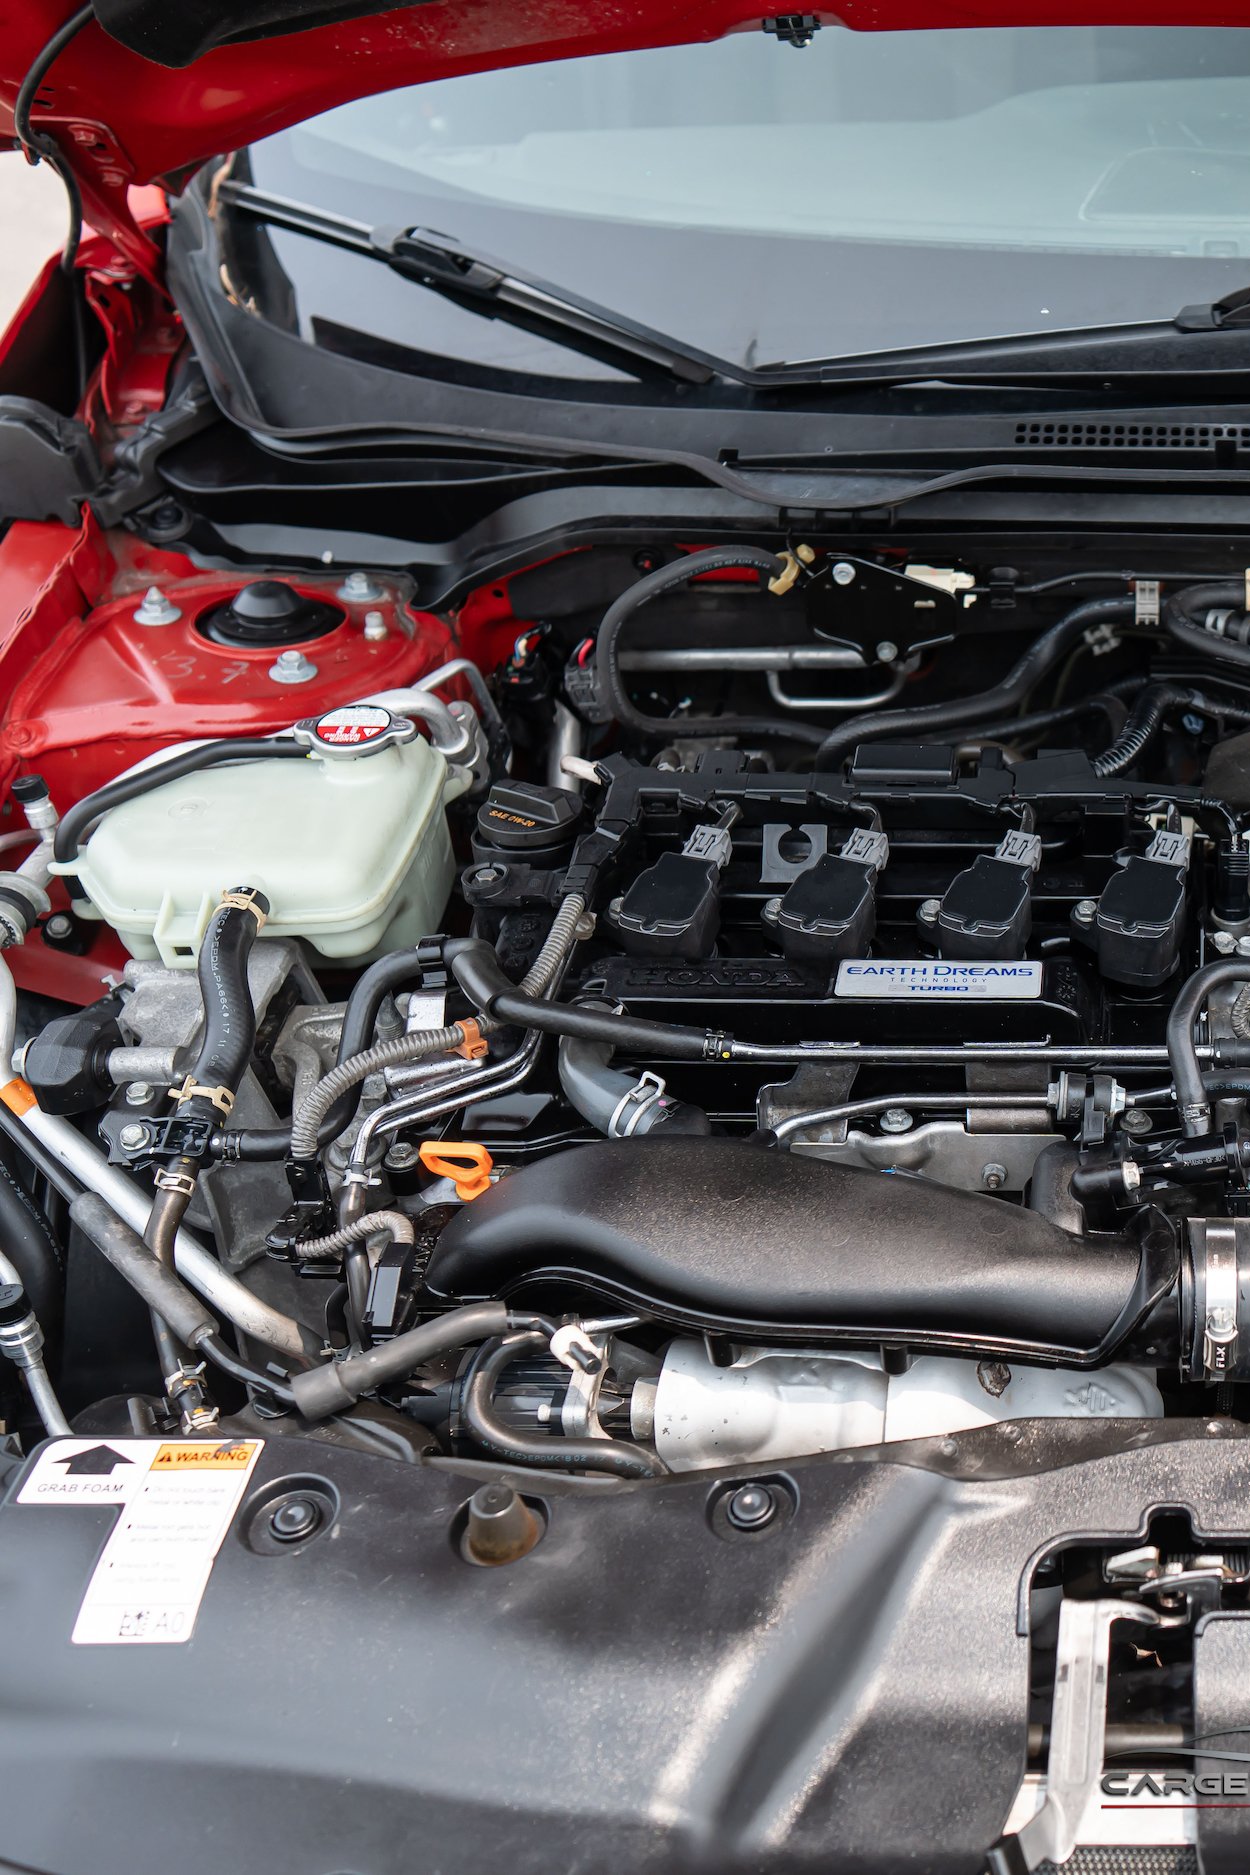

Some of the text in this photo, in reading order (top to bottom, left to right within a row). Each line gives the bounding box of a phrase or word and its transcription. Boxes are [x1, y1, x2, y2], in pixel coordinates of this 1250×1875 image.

[488, 809, 536, 828] SAE 0W-20
[626, 967, 806, 986] HONDA
[846, 965, 1033, 977] EARTH DREAMS
[176, 1451, 248, 1462] WARNING
[37, 1483, 123, 1493] GRAB FOAM
